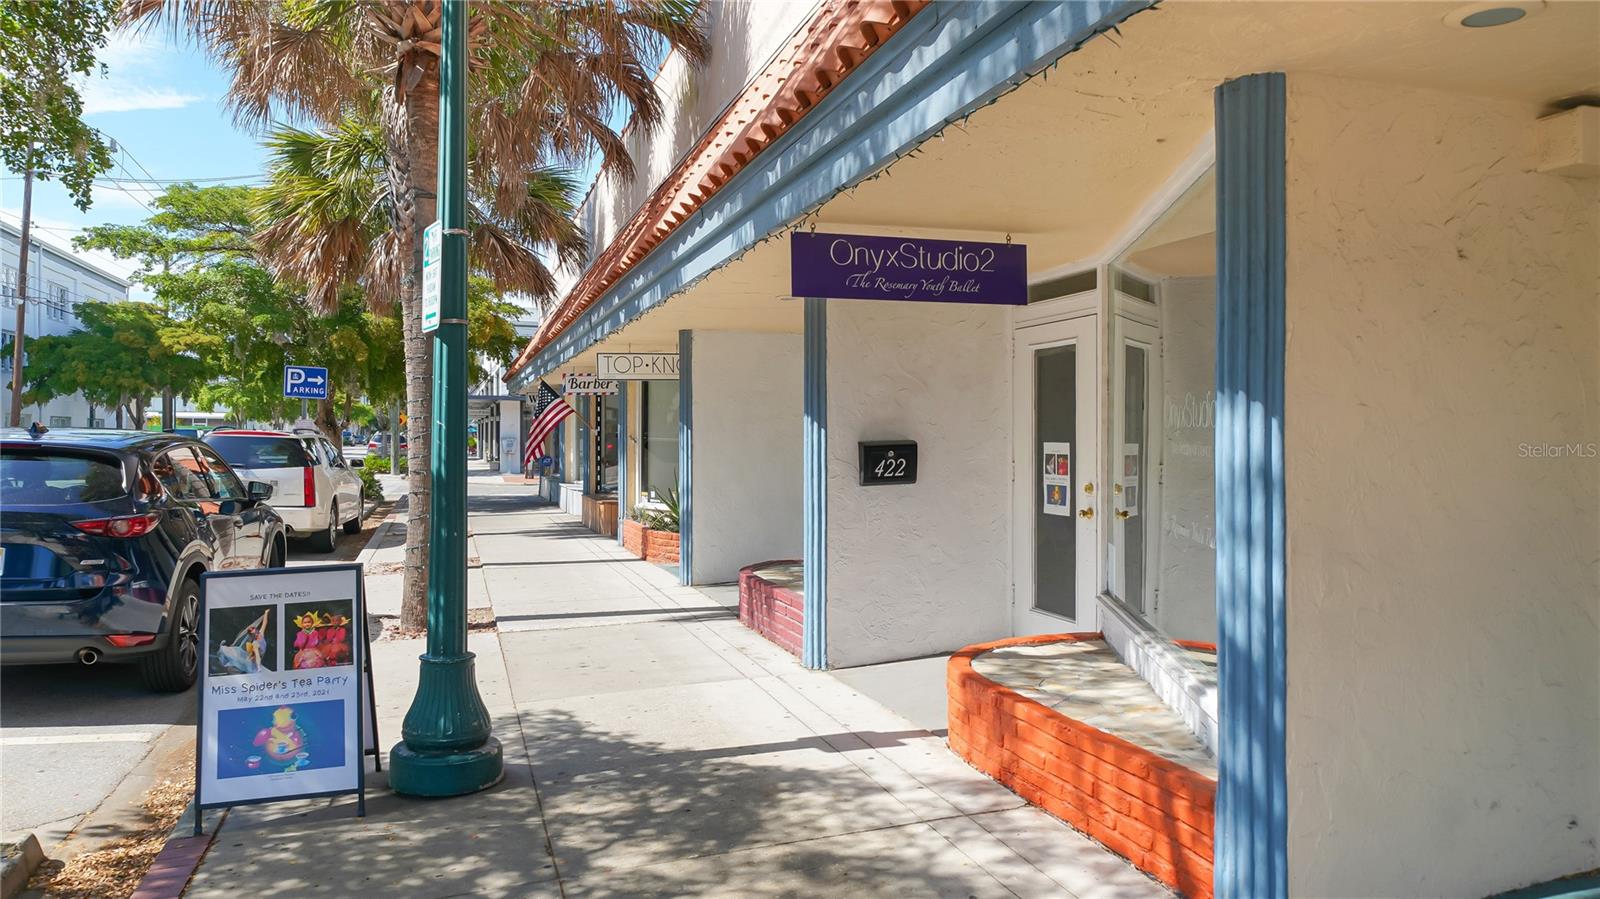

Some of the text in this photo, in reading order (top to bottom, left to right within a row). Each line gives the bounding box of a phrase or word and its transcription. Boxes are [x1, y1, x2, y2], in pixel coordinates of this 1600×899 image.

[830, 238, 995, 274] OnyxStudio2
[846, 271, 981, 298] The Rosemary Youth Ballet
[567, 377, 613, 390] Barber
[874, 458, 906, 477] 422
[249, 593, 267, 601] SAVE
[211, 685, 237, 695] Miss
[241, 680, 287, 695] Spider's
[291, 677, 313, 688] Tea
[237, 695, 253, 703] May
[254, 694, 273, 702] 22nd
[312, 689, 330, 697] 2021
